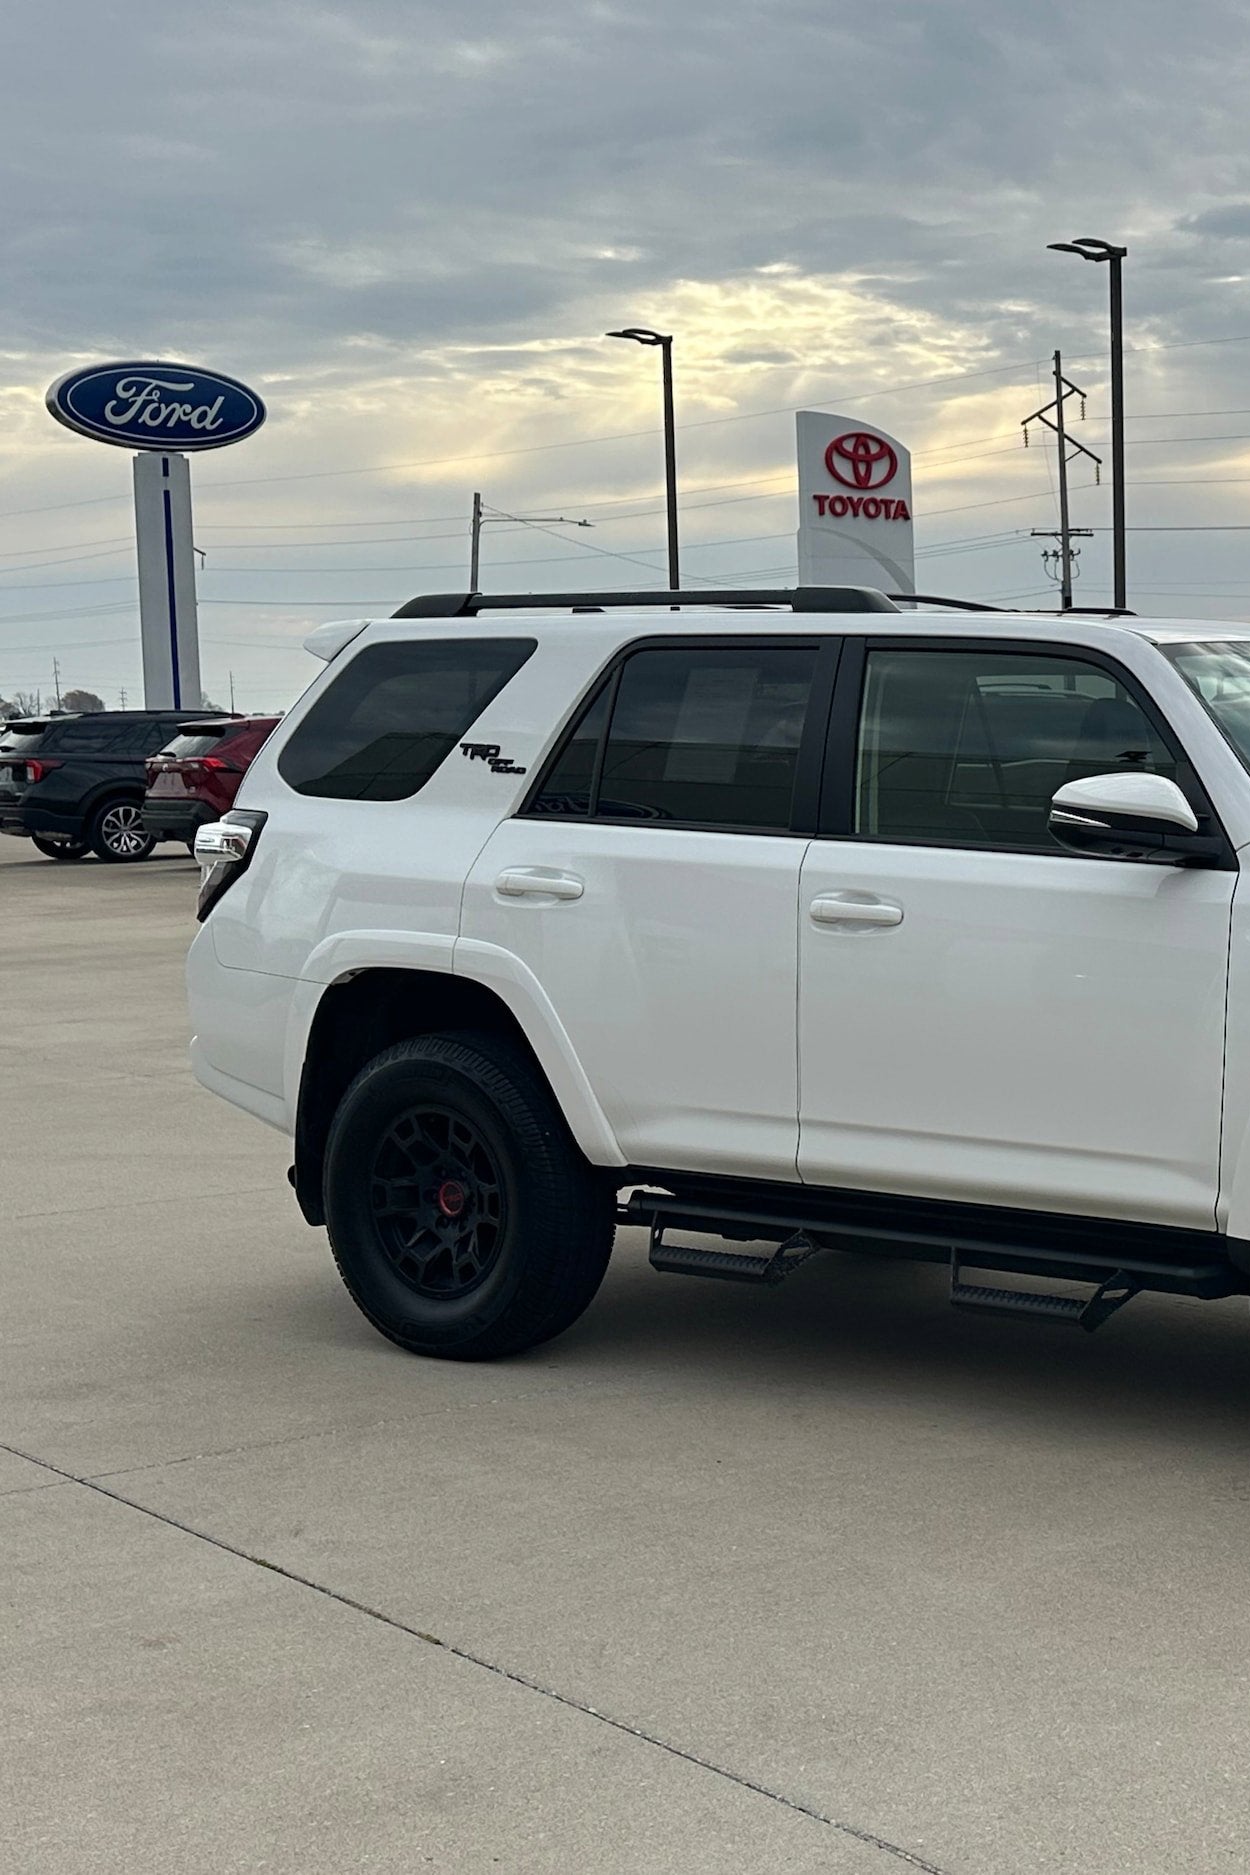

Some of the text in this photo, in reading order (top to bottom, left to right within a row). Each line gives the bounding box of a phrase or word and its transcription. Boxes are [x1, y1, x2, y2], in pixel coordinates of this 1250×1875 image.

[104, 376, 225, 431] Ford
[813, 494, 912, 522] TOYOTA
[460, 743, 501, 761] TRD
